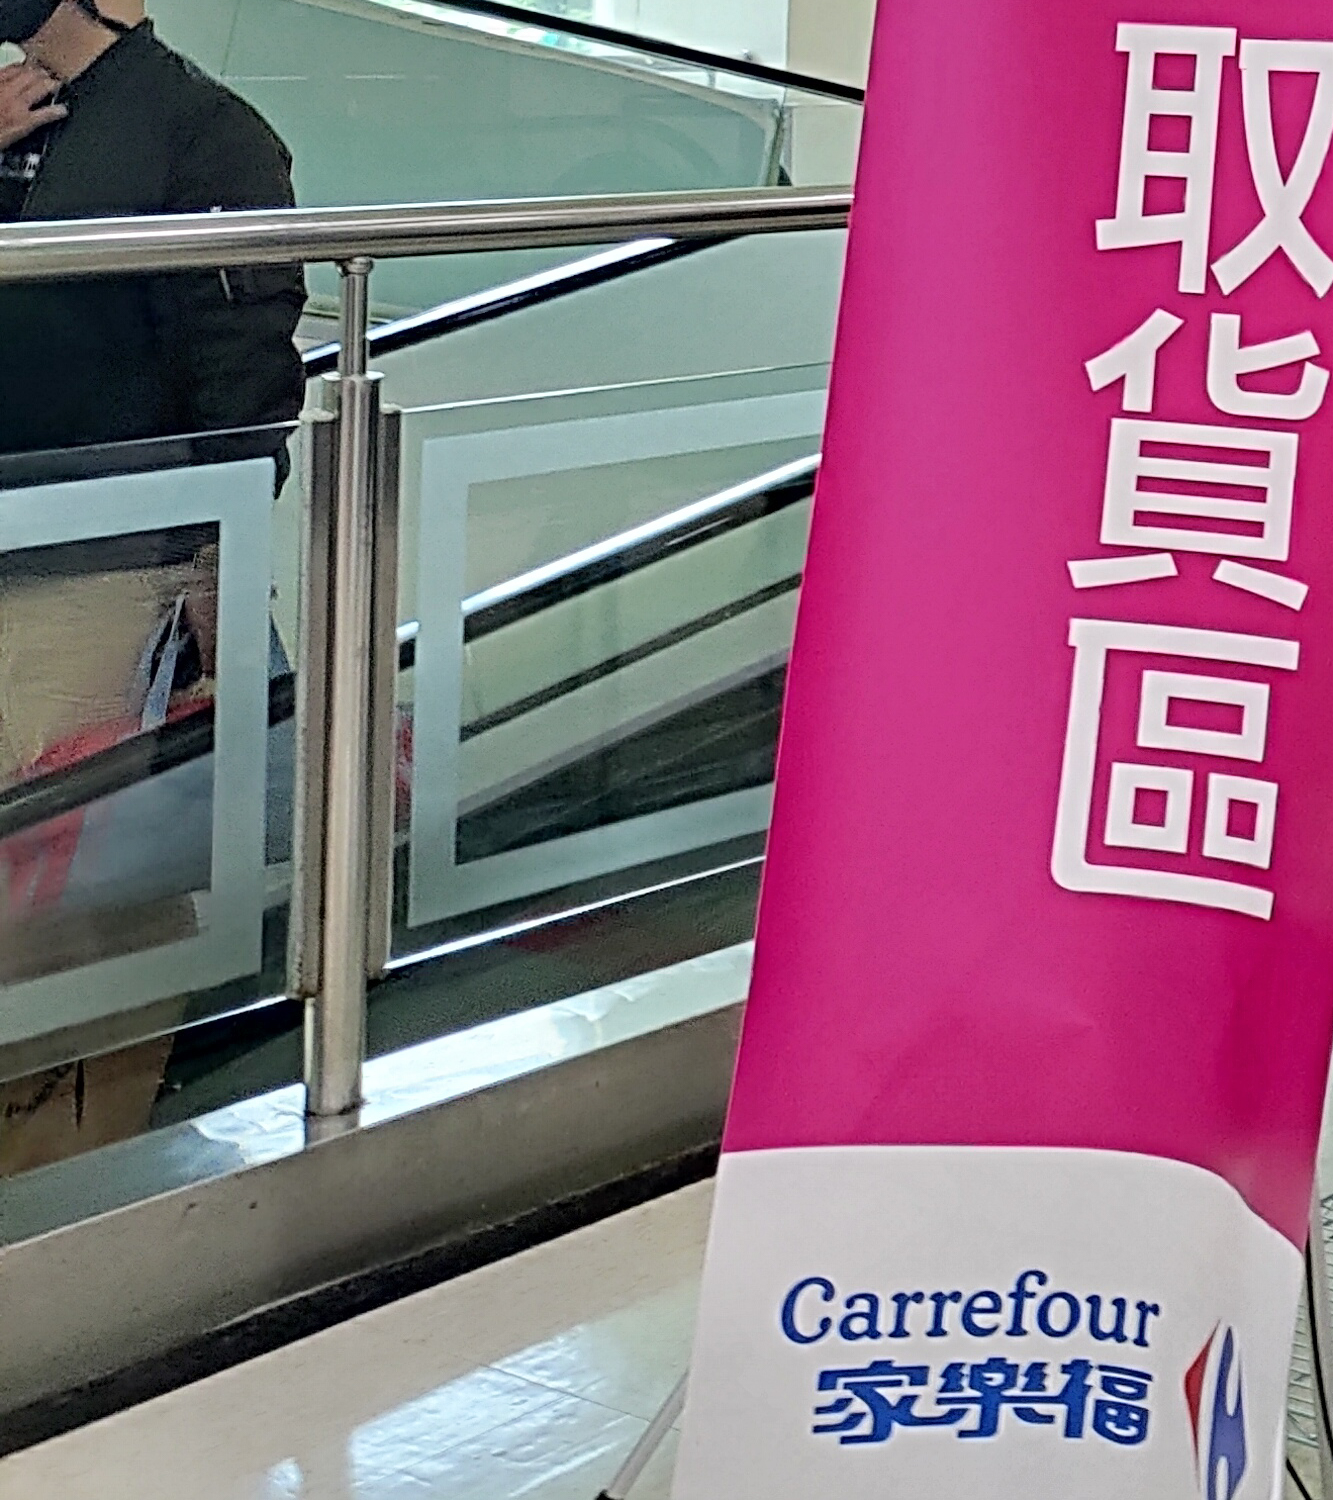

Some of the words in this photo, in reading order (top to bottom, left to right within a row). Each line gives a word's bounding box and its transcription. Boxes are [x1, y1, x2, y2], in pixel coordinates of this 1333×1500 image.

[780, 1268, 1160, 1348] Carrefour
[811, 1357, 1155, 1446] 家樂福
